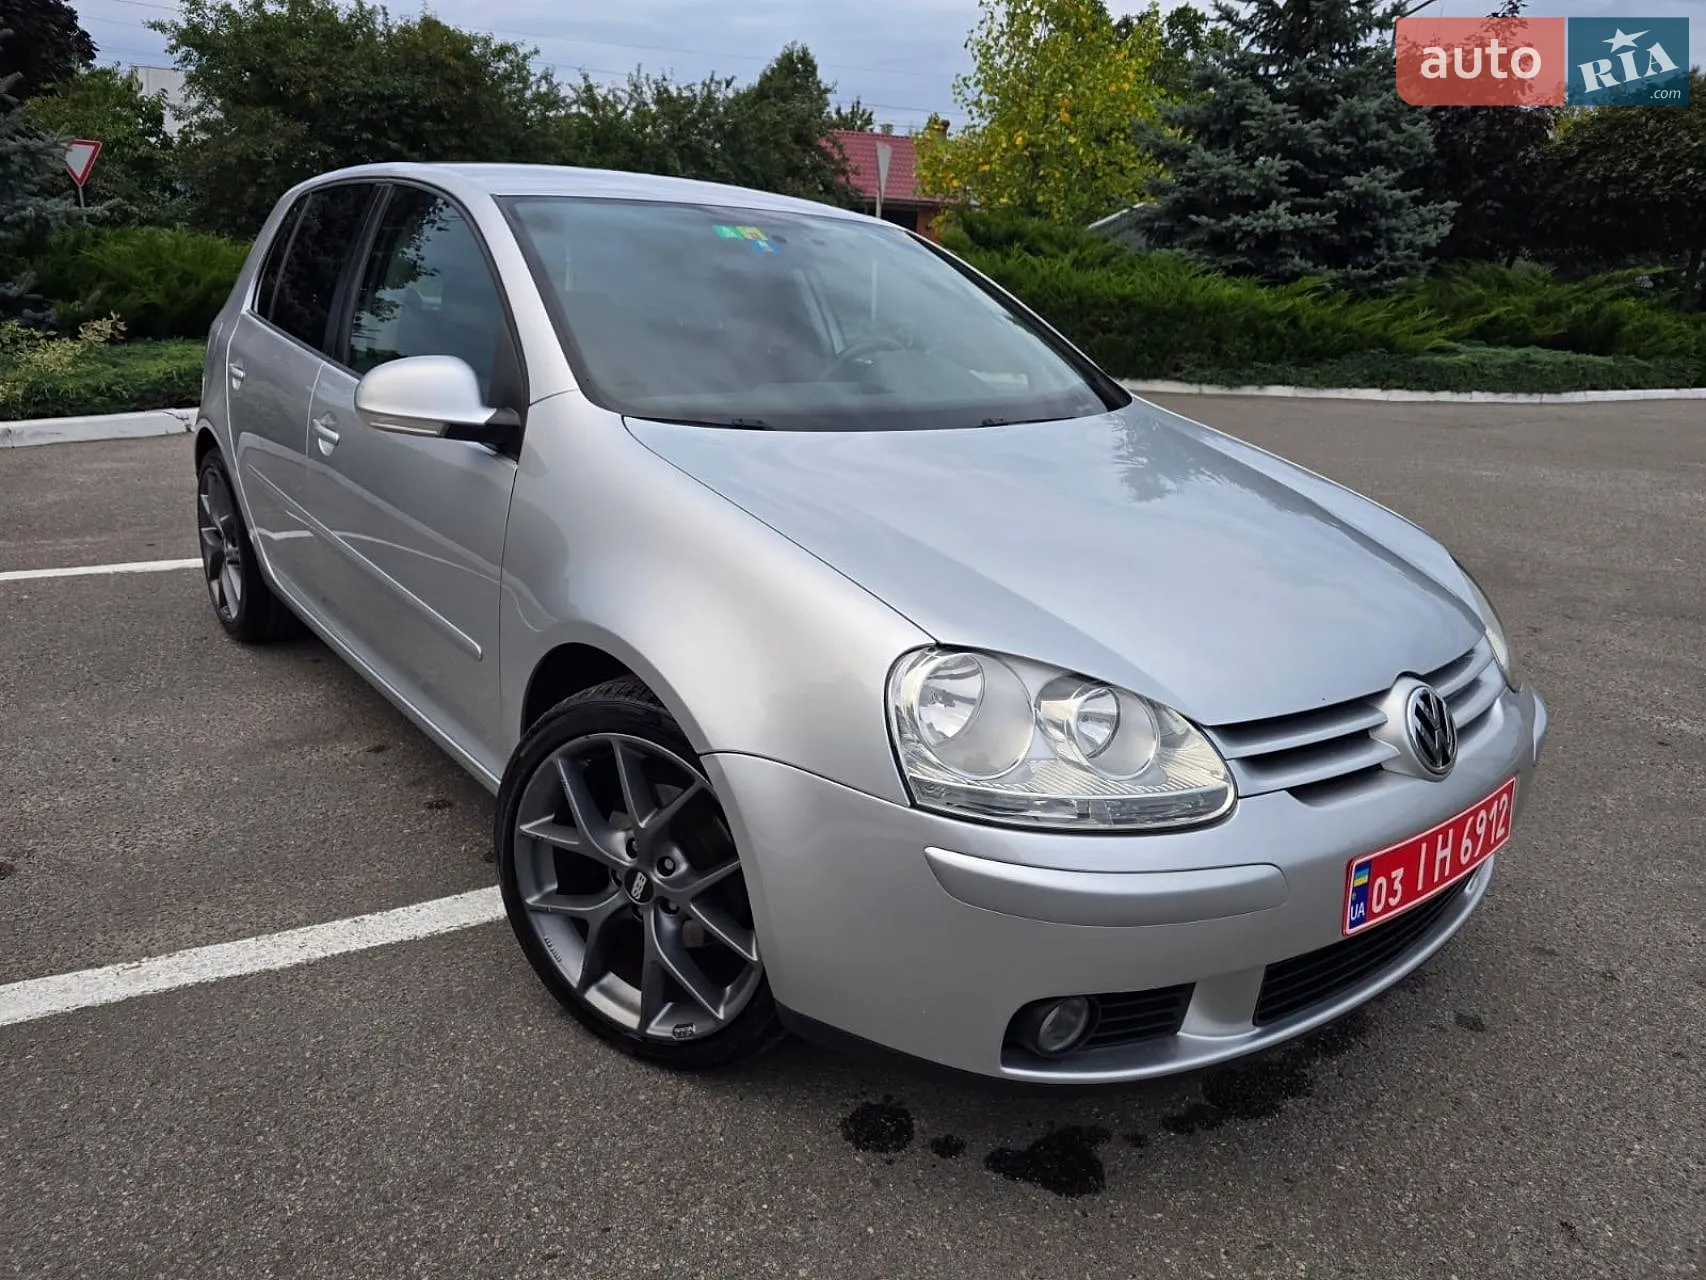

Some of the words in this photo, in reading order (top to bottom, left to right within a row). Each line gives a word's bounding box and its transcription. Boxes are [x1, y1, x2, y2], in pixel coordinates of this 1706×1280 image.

[1371, 867, 1404, 914] 03
[1459, 793, 1509, 865] 6912
[1350, 901, 1366, 920] UA
